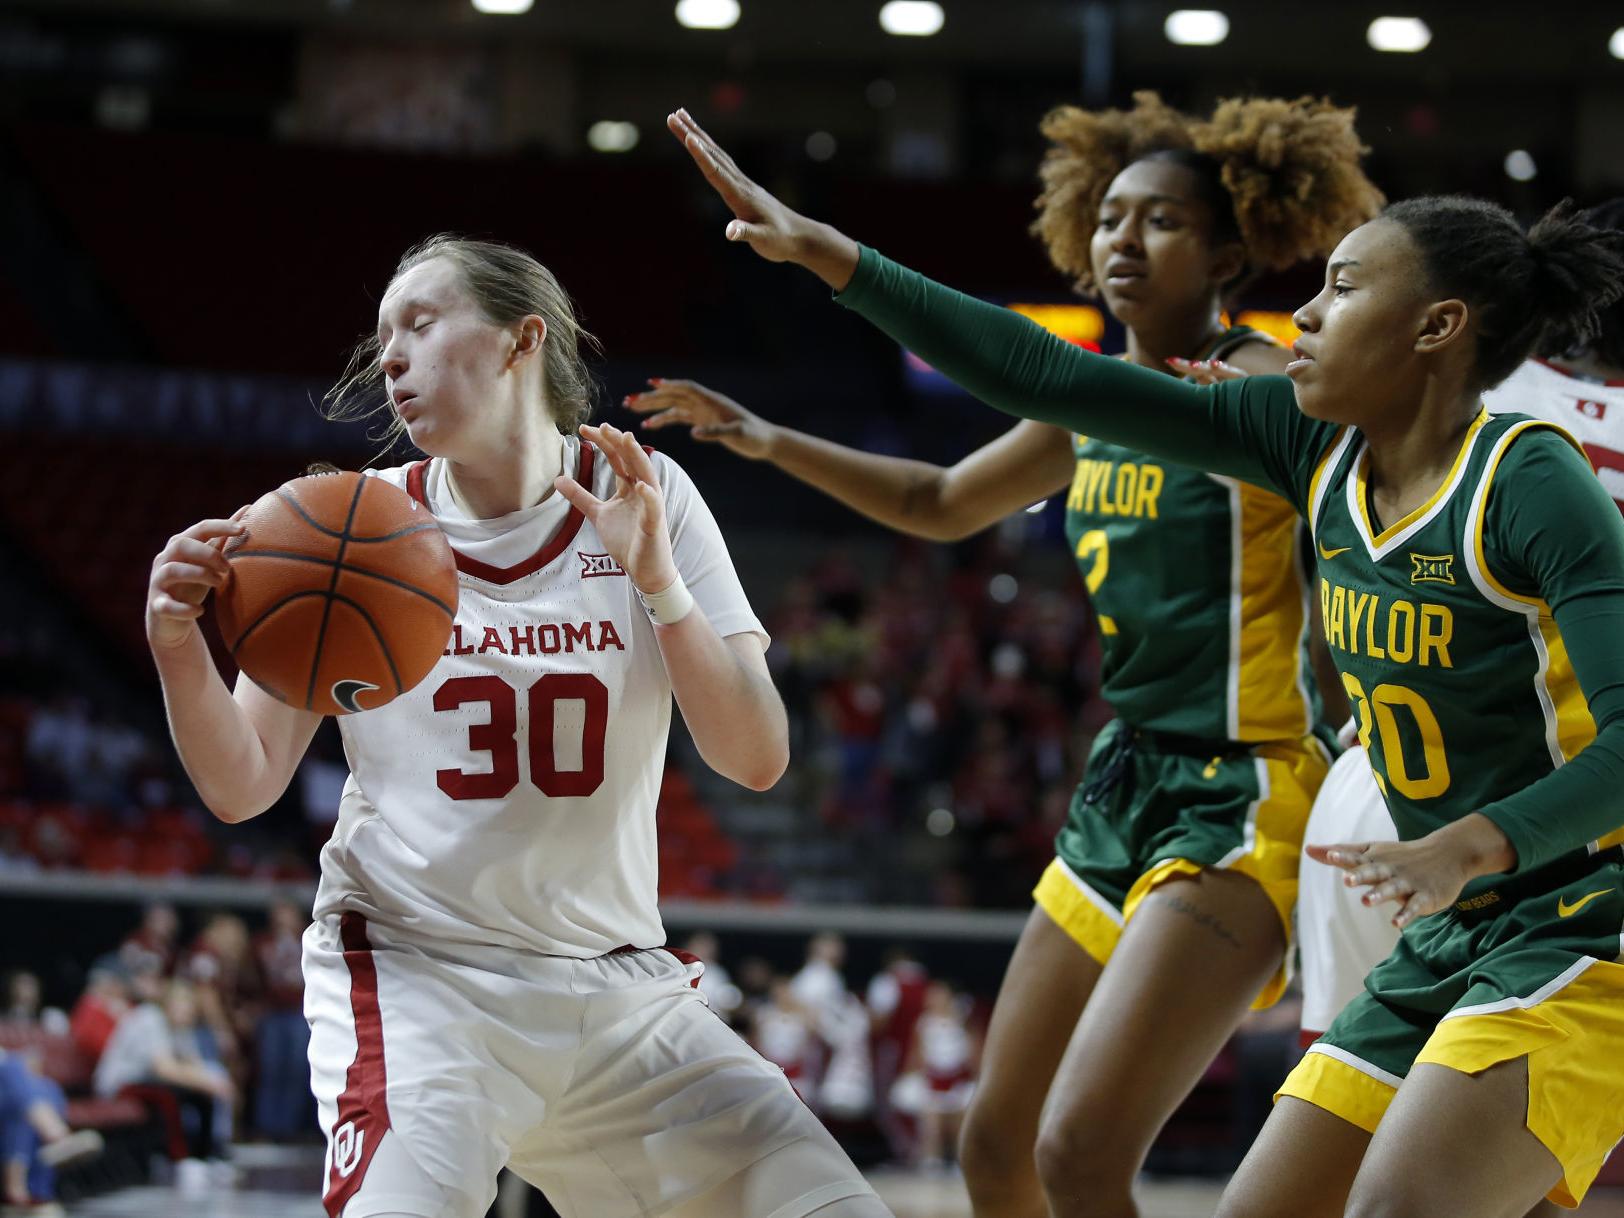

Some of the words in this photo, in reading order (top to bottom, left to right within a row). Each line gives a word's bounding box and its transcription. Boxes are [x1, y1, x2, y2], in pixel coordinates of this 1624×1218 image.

[1066, 459, 1165, 520] AYLOR
[443, 620, 625, 656] LAHOMA
[1321, 577, 1454, 668] BAYLOR
[433, 673, 609, 800] 30
